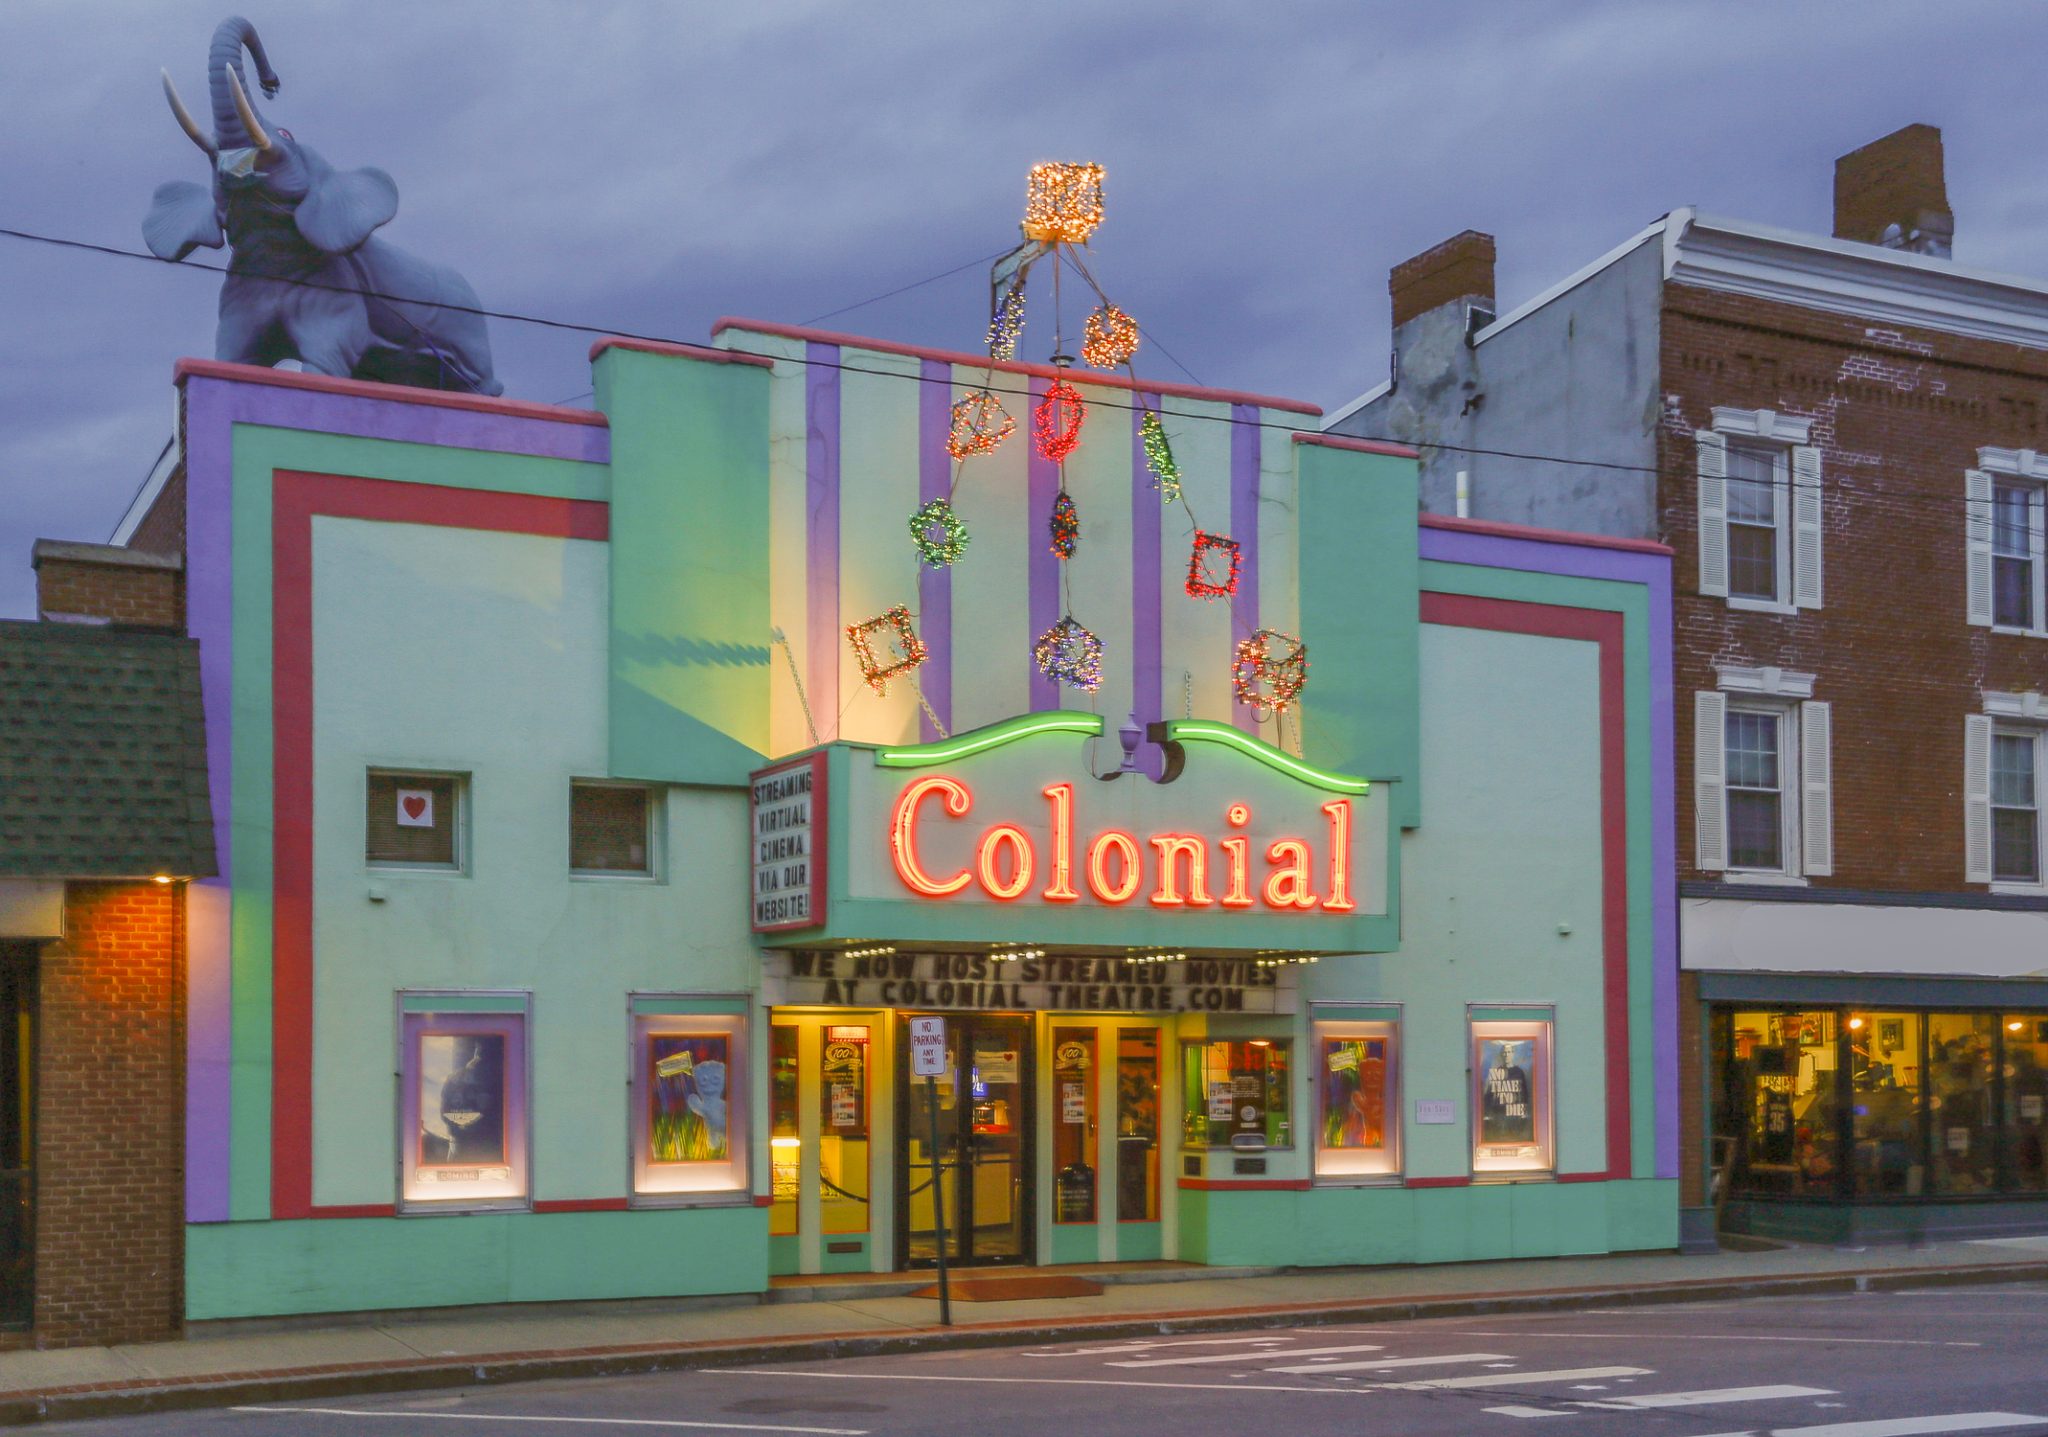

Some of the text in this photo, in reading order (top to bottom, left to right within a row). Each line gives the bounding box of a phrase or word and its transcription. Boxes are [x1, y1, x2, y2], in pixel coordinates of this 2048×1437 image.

[754, 771, 812, 805] STREAMING
[758, 803, 806, 832] VIRTUAL
[760, 834, 803, 862] CINEMA
[891, 774, 1356, 912] Colonial
[758, 863, 806, 891] VIA OUR
[756, 893, 808, 922] WEBSITE!
[792, 951, 1277, 985] WE NOW HOST STREAMED MOVIES
[822, 978, 859, 1004] AT
[880, 980, 1027, 1008] COLONIAL
[921, 1021, 932, 1033] NO
[913, 1034, 942, 1046] PARKING
[922, 1049, 934, 1057] ANY
[922, 1057, 936, 1065] TIME
[1488, 1067, 1506, 1080] NO
[1490, 1080, 1521, 1093] TIME
[1497, 1092, 1514, 1105] TO
[1505, 1103, 1526, 1116] DIE
